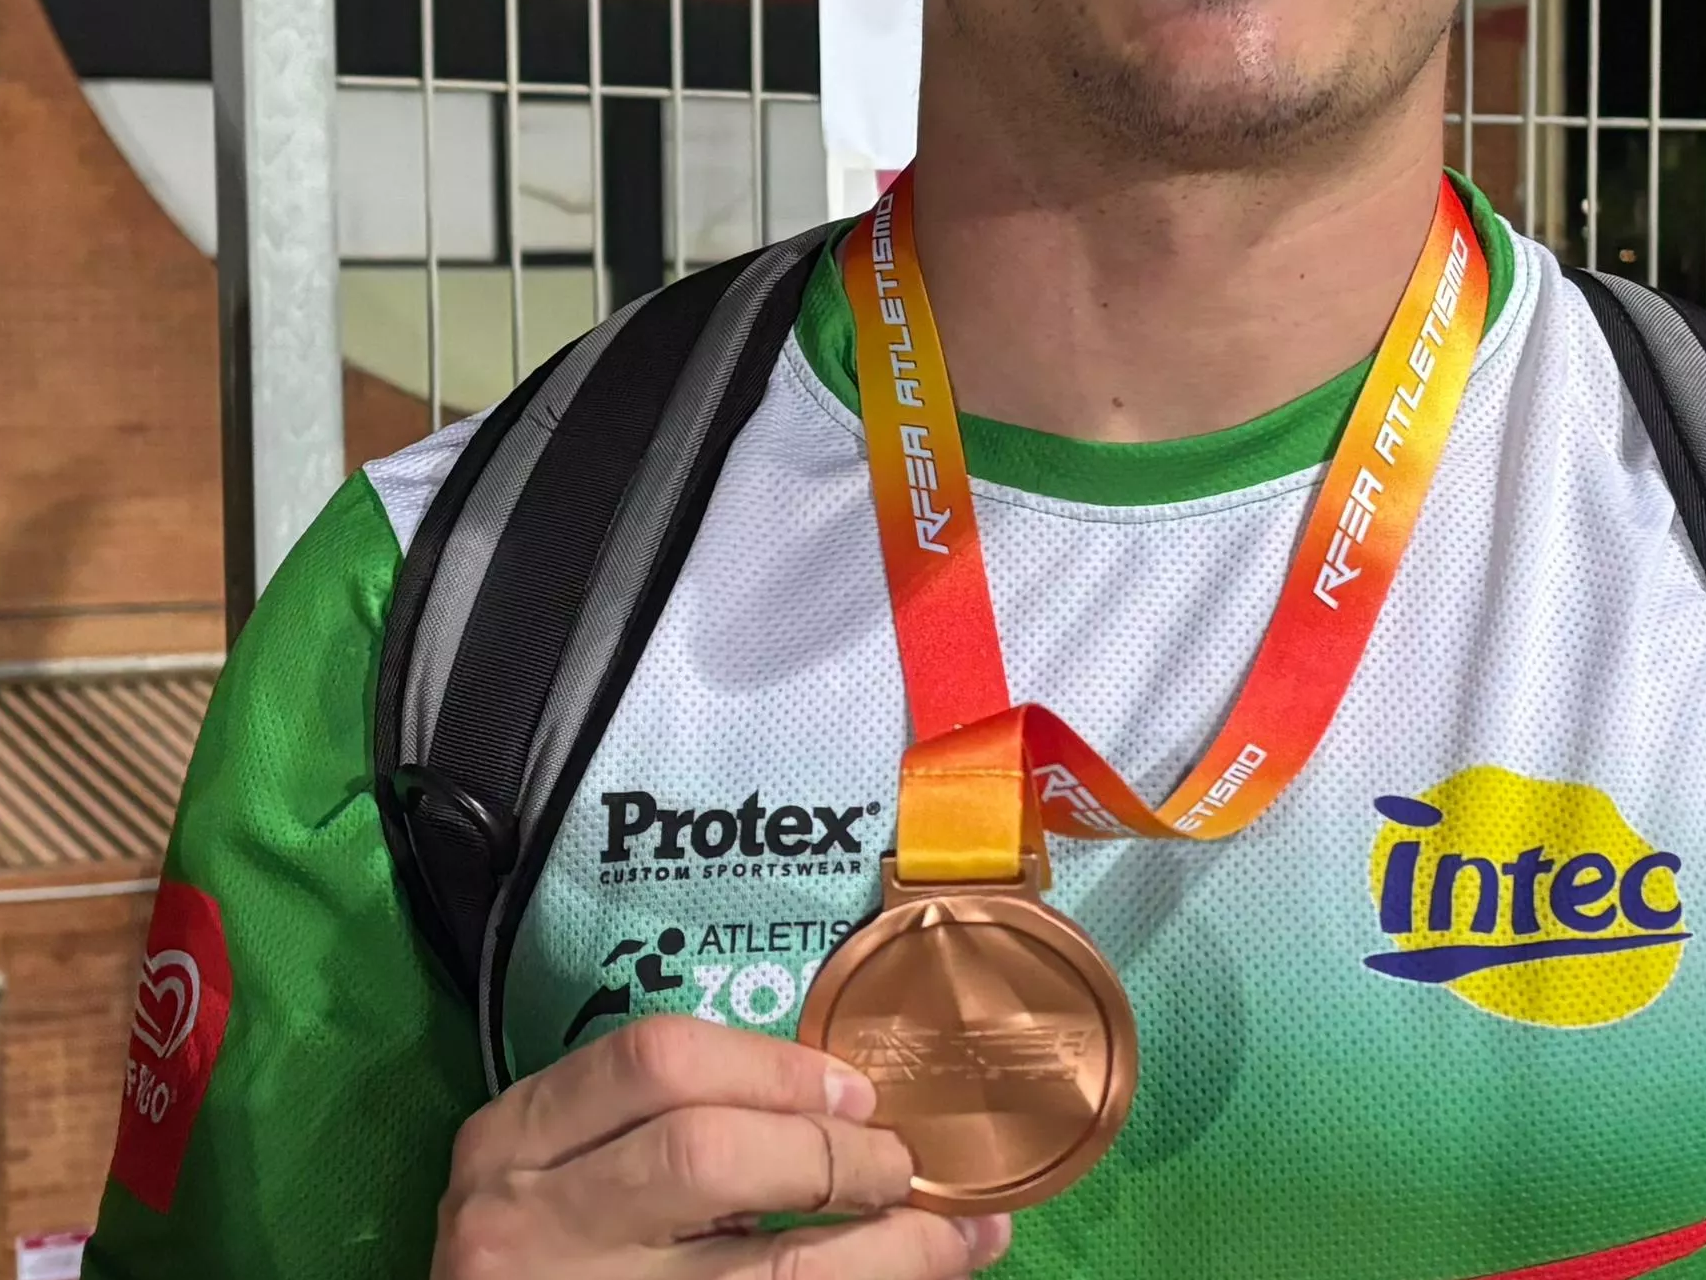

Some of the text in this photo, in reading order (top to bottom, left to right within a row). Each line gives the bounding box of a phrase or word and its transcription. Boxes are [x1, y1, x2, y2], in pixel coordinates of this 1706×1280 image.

[872, 193, 952, 555] RFEA ATLETISMO
[1312, 226, 1469, 610] RFEA ATLETISMO
[1031, 743, 1268, 837] RFE ETISMO
[599, 860, 862, 885] CUSTOM SPORTSWEAR
[696, 920, 852, 956] ATLETIS
